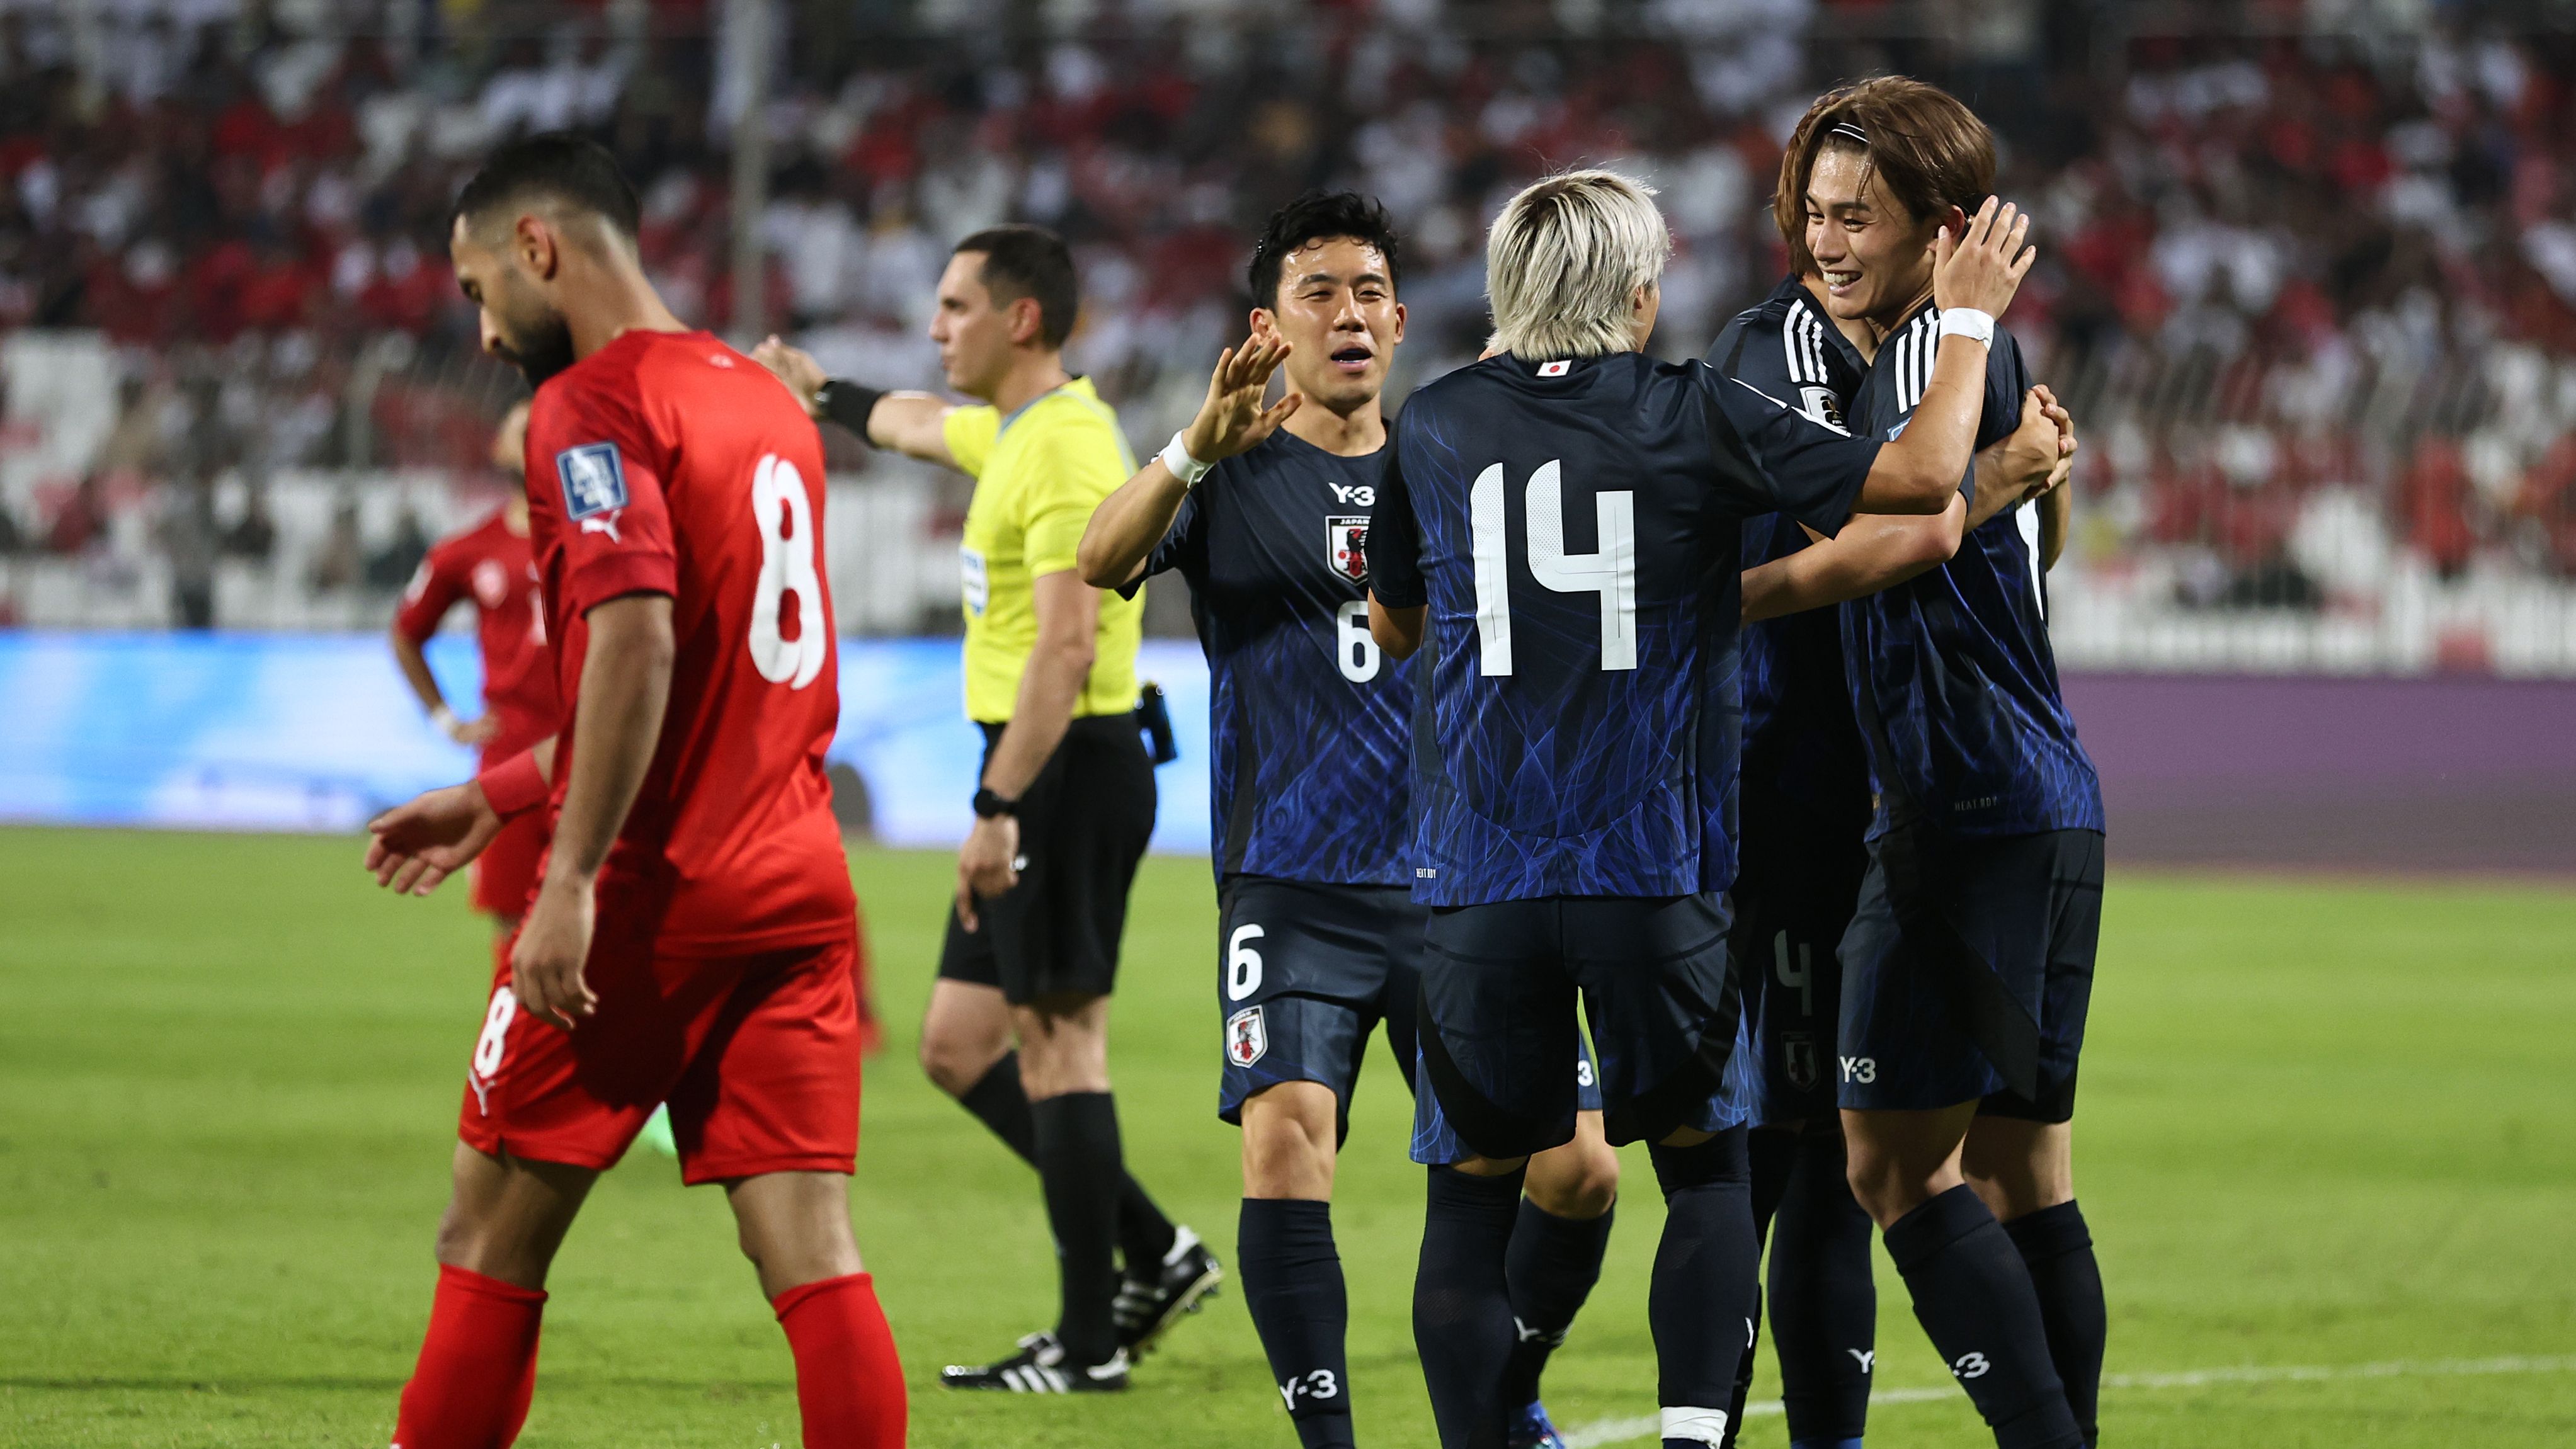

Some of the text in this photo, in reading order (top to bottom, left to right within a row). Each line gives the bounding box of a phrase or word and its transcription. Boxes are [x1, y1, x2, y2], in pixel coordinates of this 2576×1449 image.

[1328, 482, 1376, 507] Y-3
[749, 453, 826, 690] 8
[1470, 458, 1636, 676] 14
[1337, 600, 1381, 683] 6
[1228, 923, 1265, 1001] 6
[1774, 929, 1812, 1016] 4
[474, 986, 516, 1078] 8
[1839, 1056, 1876, 1083] Y-3
[1279, 1368, 1338, 1411] Y-3
